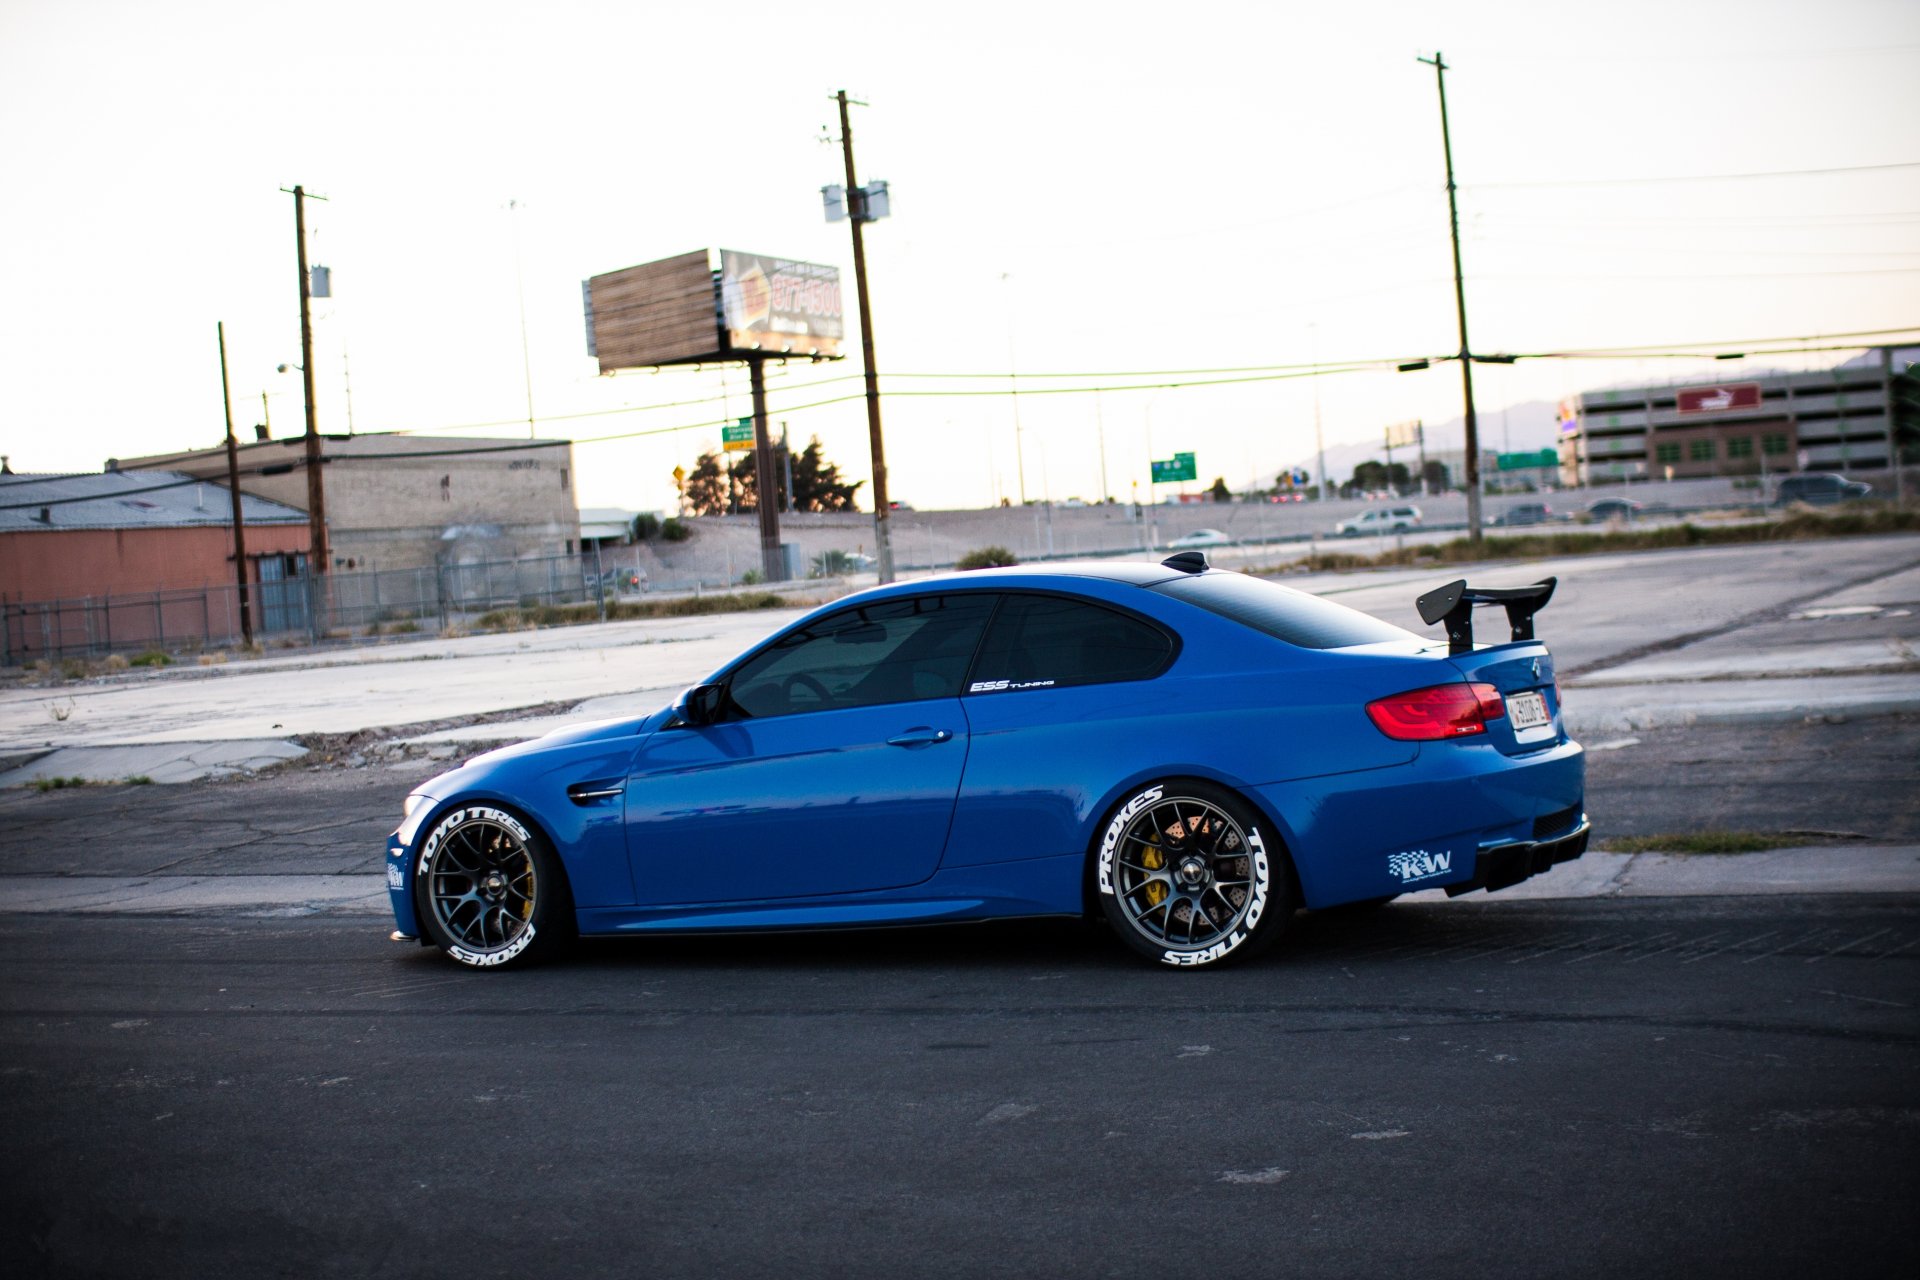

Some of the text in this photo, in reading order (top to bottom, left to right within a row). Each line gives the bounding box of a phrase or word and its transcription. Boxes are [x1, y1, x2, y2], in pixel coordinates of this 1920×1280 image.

[970, 680, 1055, 692] ESS TUNING
[418, 806, 532, 876] TOYO TIRES
[1099, 784, 1164, 895] PROXES
[1401, 850, 1451, 879] KW
[1161, 827, 1269, 966] TOYO TIRES
[448, 922, 537, 966] PROXES
